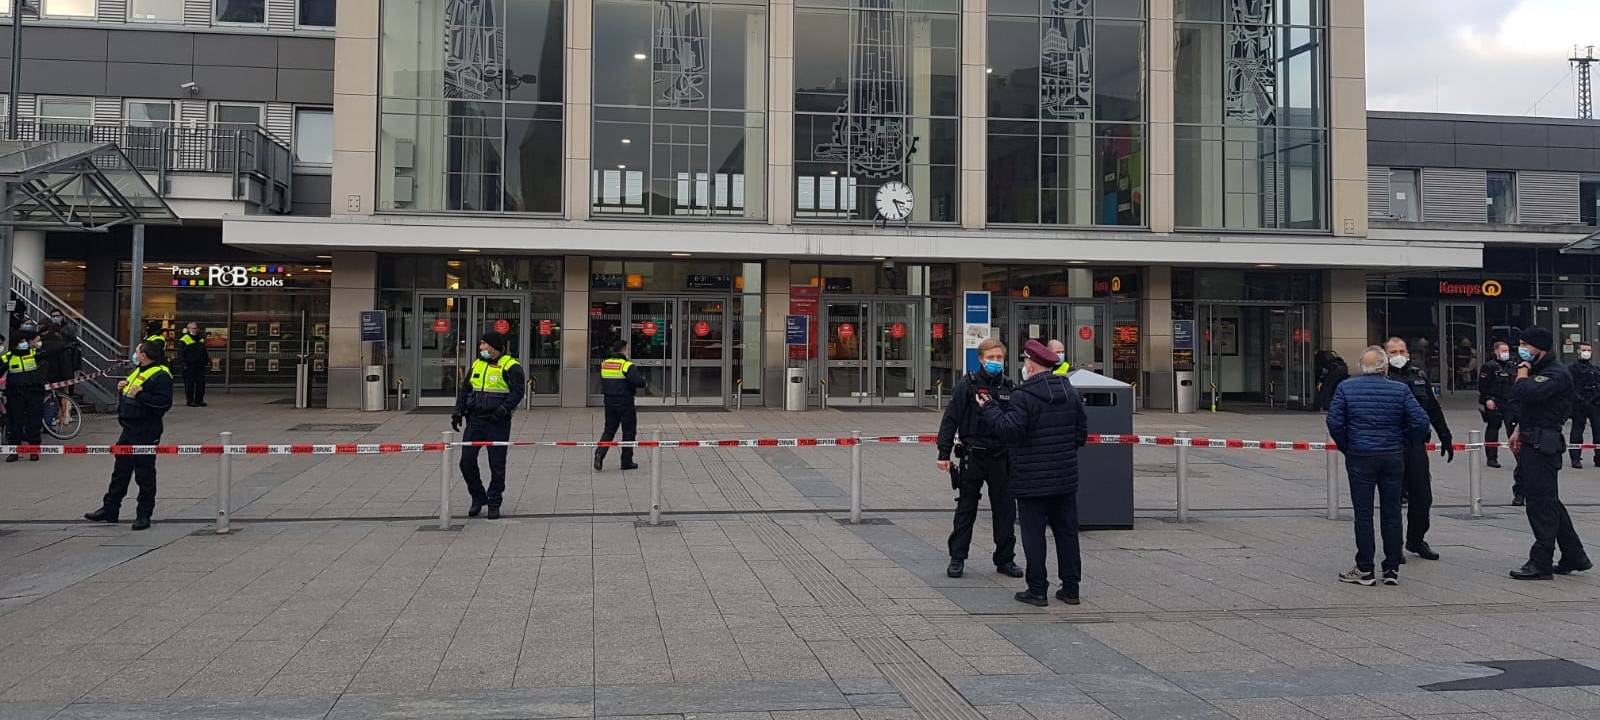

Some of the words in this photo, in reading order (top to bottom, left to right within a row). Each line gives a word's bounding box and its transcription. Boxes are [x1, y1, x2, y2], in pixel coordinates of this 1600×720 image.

[172, 265, 201, 276] Press
[208, 265, 248, 287] P&B
[250, 277, 284, 287] Books
[1439, 281, 1481, 296] Kamps
